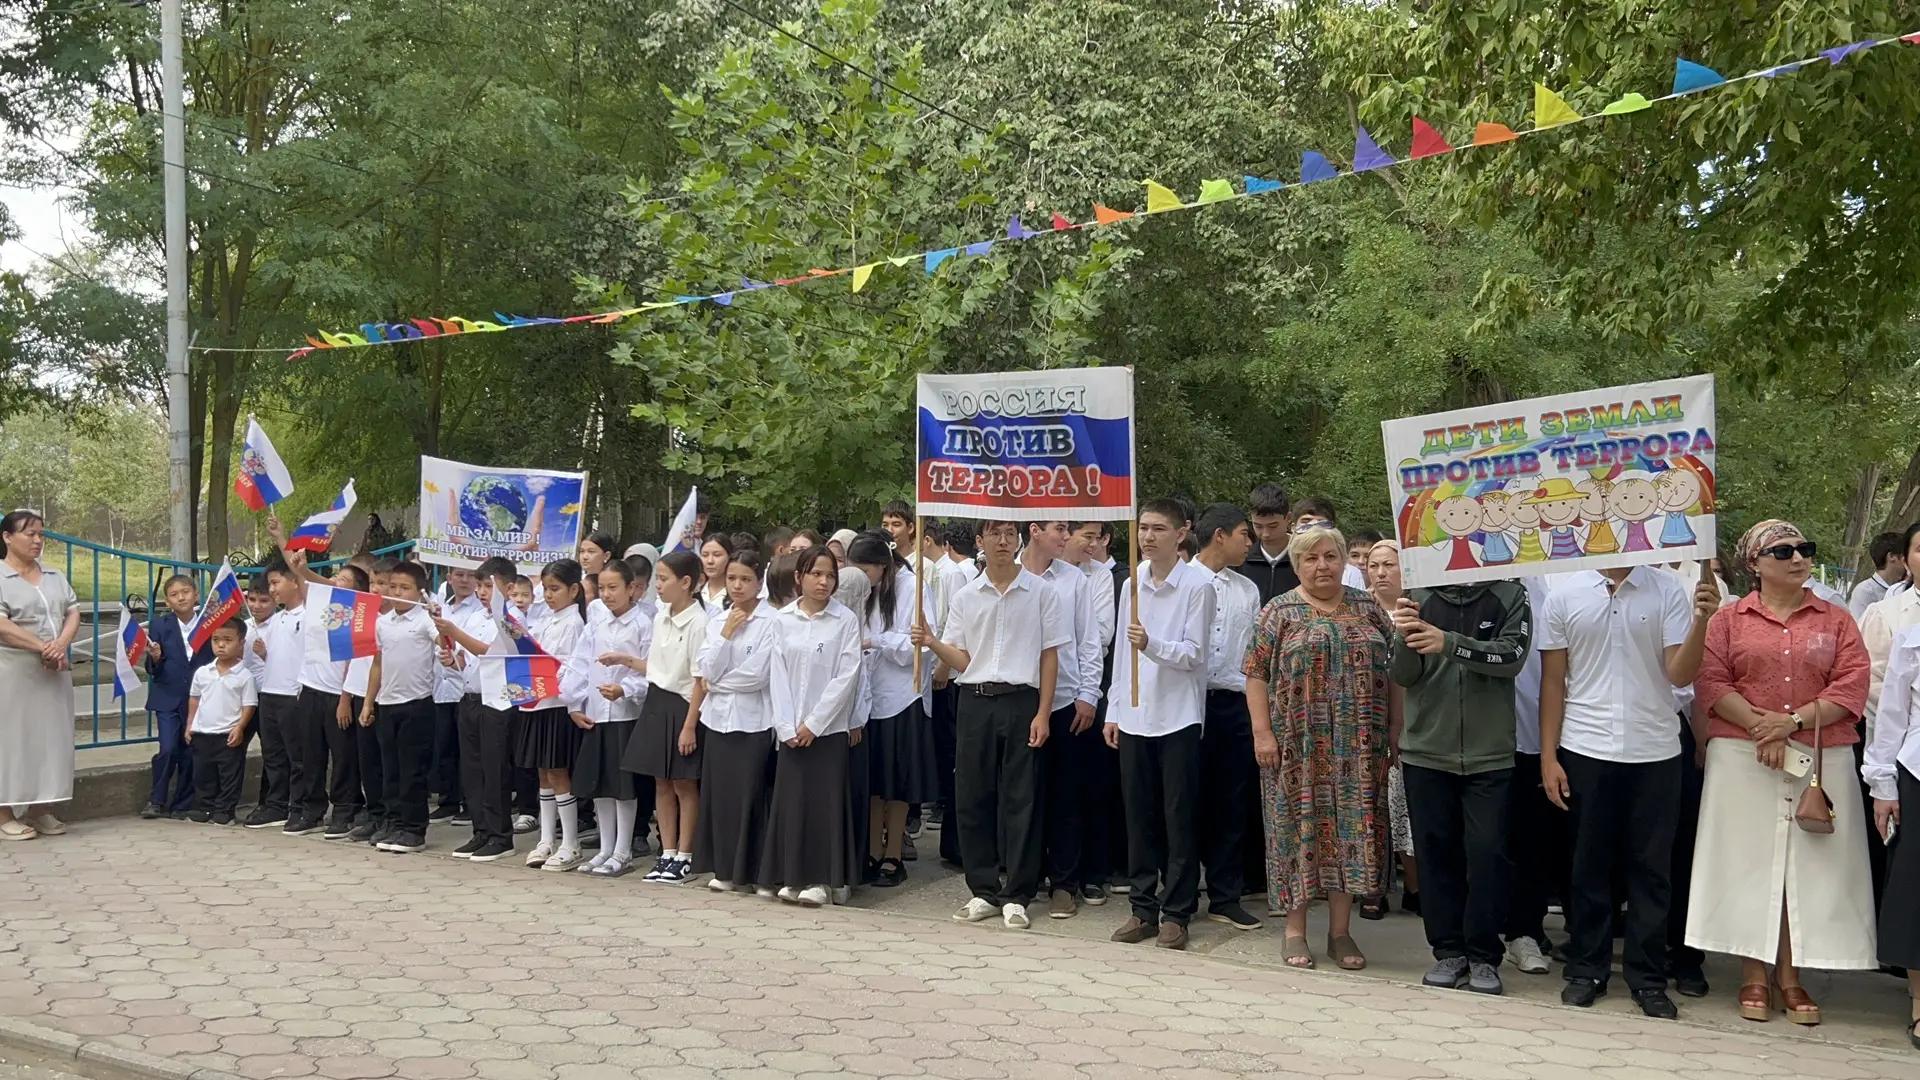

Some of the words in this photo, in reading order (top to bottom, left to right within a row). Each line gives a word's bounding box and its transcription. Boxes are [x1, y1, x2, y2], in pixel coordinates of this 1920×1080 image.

[941, 386, 1086, 418] РОССИЯ
[943, 425, 1075, 457] ПРОТИВ
[1420, 416, 1528, 457] ДЕТИ
[1539, 394, 1684, 436] ЗЕМЛИ
[1400, 450, 1541, 491] ПРОТИВ
[1550, 427, 1715, 470] ТЕРРОРА
[928, 461, 1079, 497] ТЕРРОРА
[440, 541, 489, 558] ПРОТИВ
[447, 524, 472, 538] МЫ
[474, 528, 493, 541] ЗА
[497, 531, 531, 544] МИР
